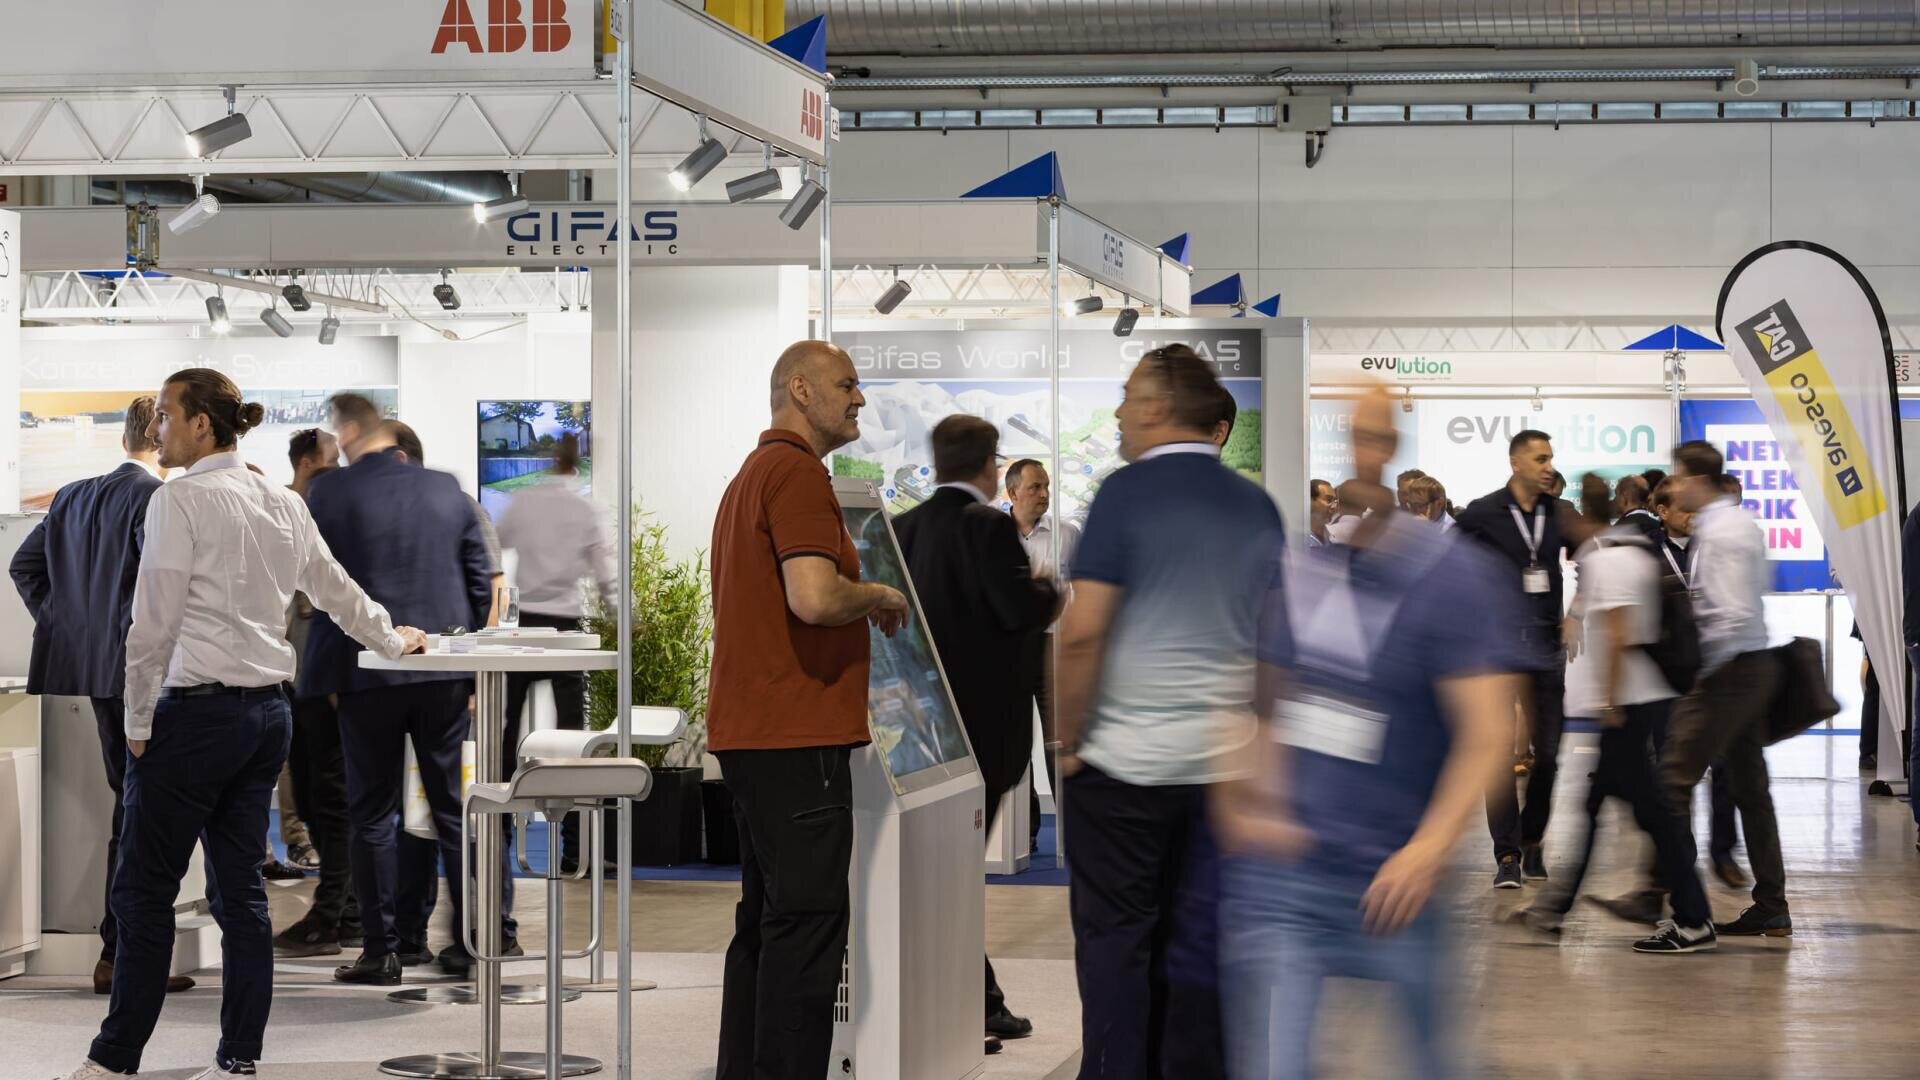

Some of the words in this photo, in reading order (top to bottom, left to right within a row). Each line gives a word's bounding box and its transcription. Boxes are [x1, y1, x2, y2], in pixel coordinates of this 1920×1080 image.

[431, 0, 572, 53] ABB
[801, 88, 822, 140] ABB
[507, 211, 678, 241] GIFAS
[507, 245, 678, 256] ELECTIC
[847, 344, 942, 369] Gifas
[957, 344, 1071, 369] World
[1361, 356, 1451, 374] evulution
